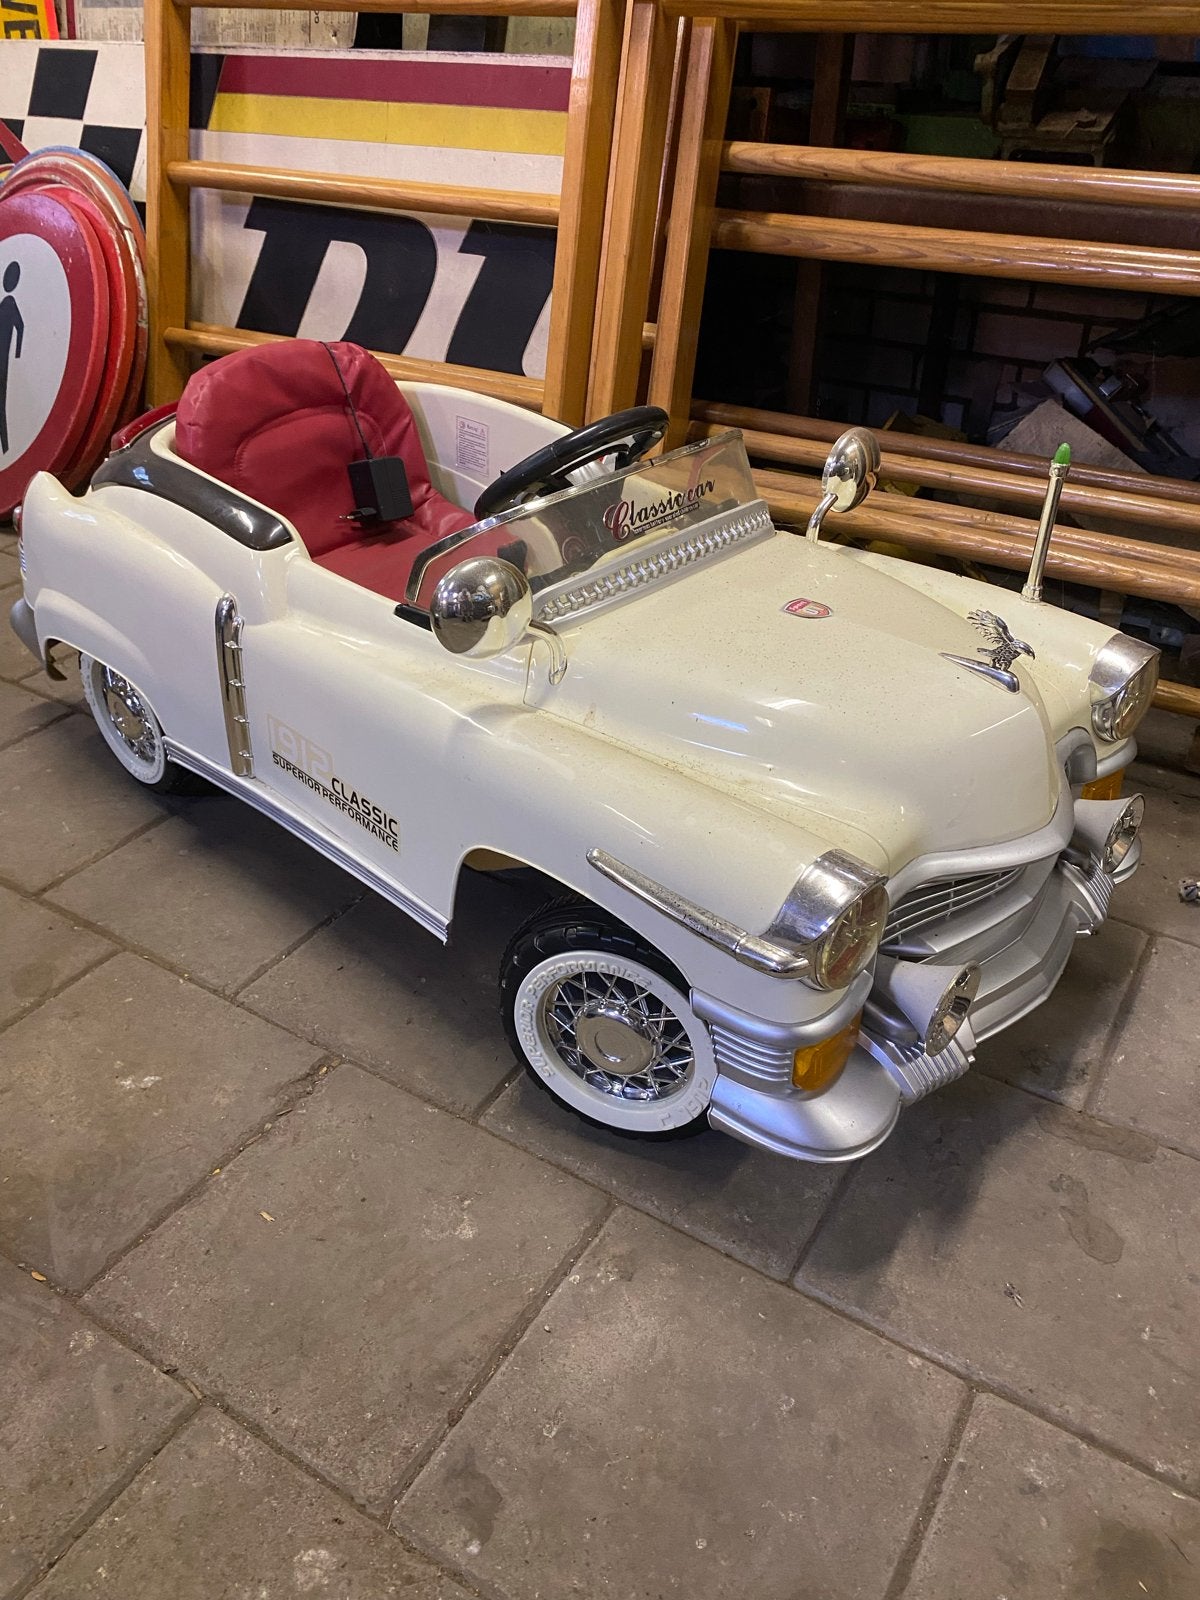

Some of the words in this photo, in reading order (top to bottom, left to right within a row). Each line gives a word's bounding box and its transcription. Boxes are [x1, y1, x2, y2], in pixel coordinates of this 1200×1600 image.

[602, 491, 686, 542] Classic
[687, 479, 716, 503] car
[272, 752, 321, 795] SUPERIOR
[322, 788, 399, 852] PERFORMANCE
[331, 777, 398, 838] CLASSIC
[525, 959, 652, 999] PERFORMANCE
[520, 999, 556, 1078] SUPERIOR
